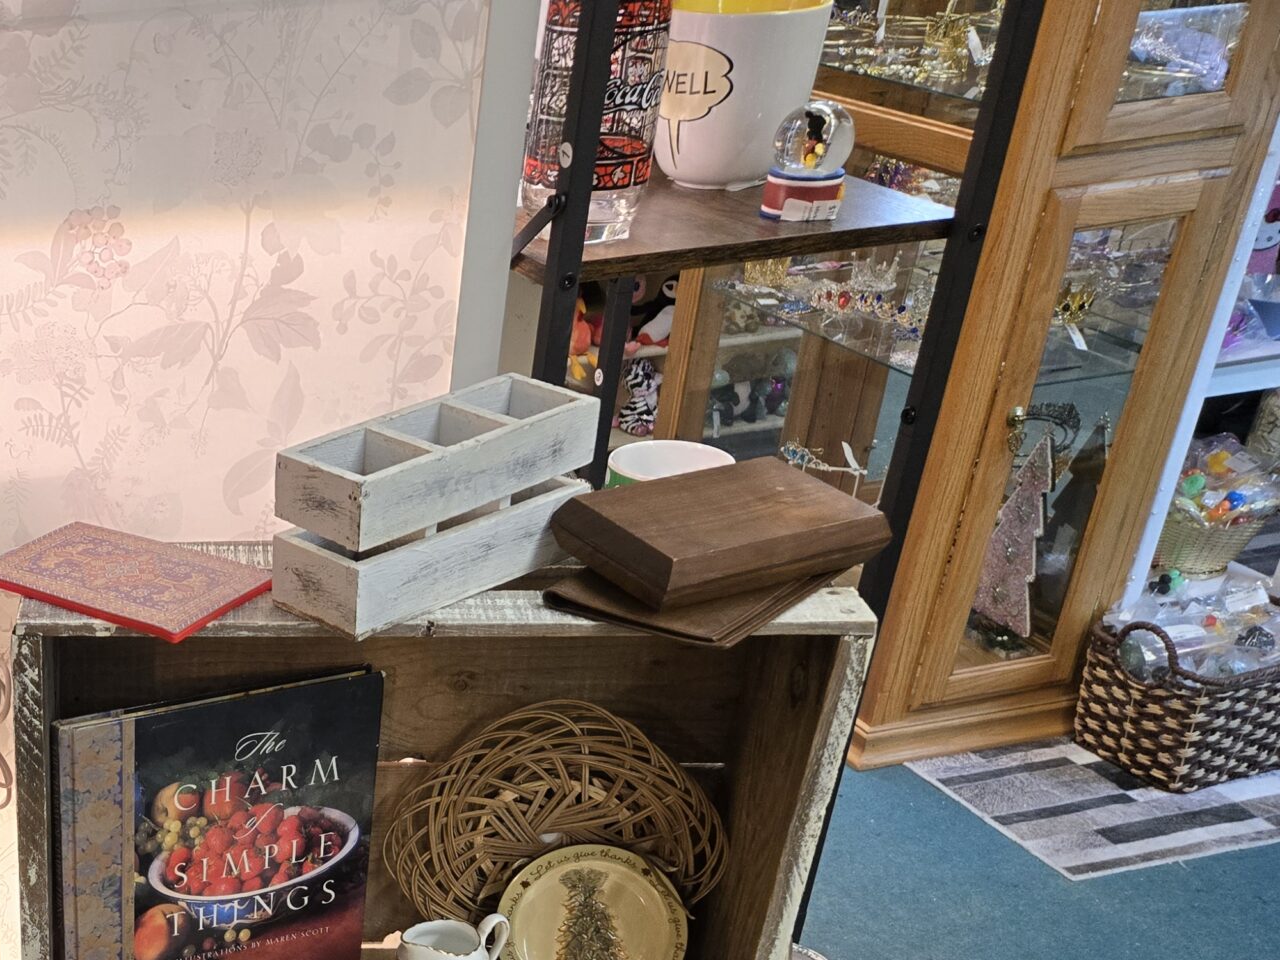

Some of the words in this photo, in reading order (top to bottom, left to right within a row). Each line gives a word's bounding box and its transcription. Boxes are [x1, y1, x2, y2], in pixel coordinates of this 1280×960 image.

[234, 731, 286, 762] The
[173, 755, 341, 812] CHARM
[233, 803, 284, 840] of
[173, 831, 336, 889] SIMPLE
[529, 861, 556, 881] Let
[557, 855, 570, 865] us
[573, 850, 598, 863] give
[599, 848, 637, 868] thanks
[166, 879, 337, 937] THINGS
[251, 939, 262, 949] BY
[265, 933, 297, 946] MAREN
[300, 926, 331, 939] SCOTT
